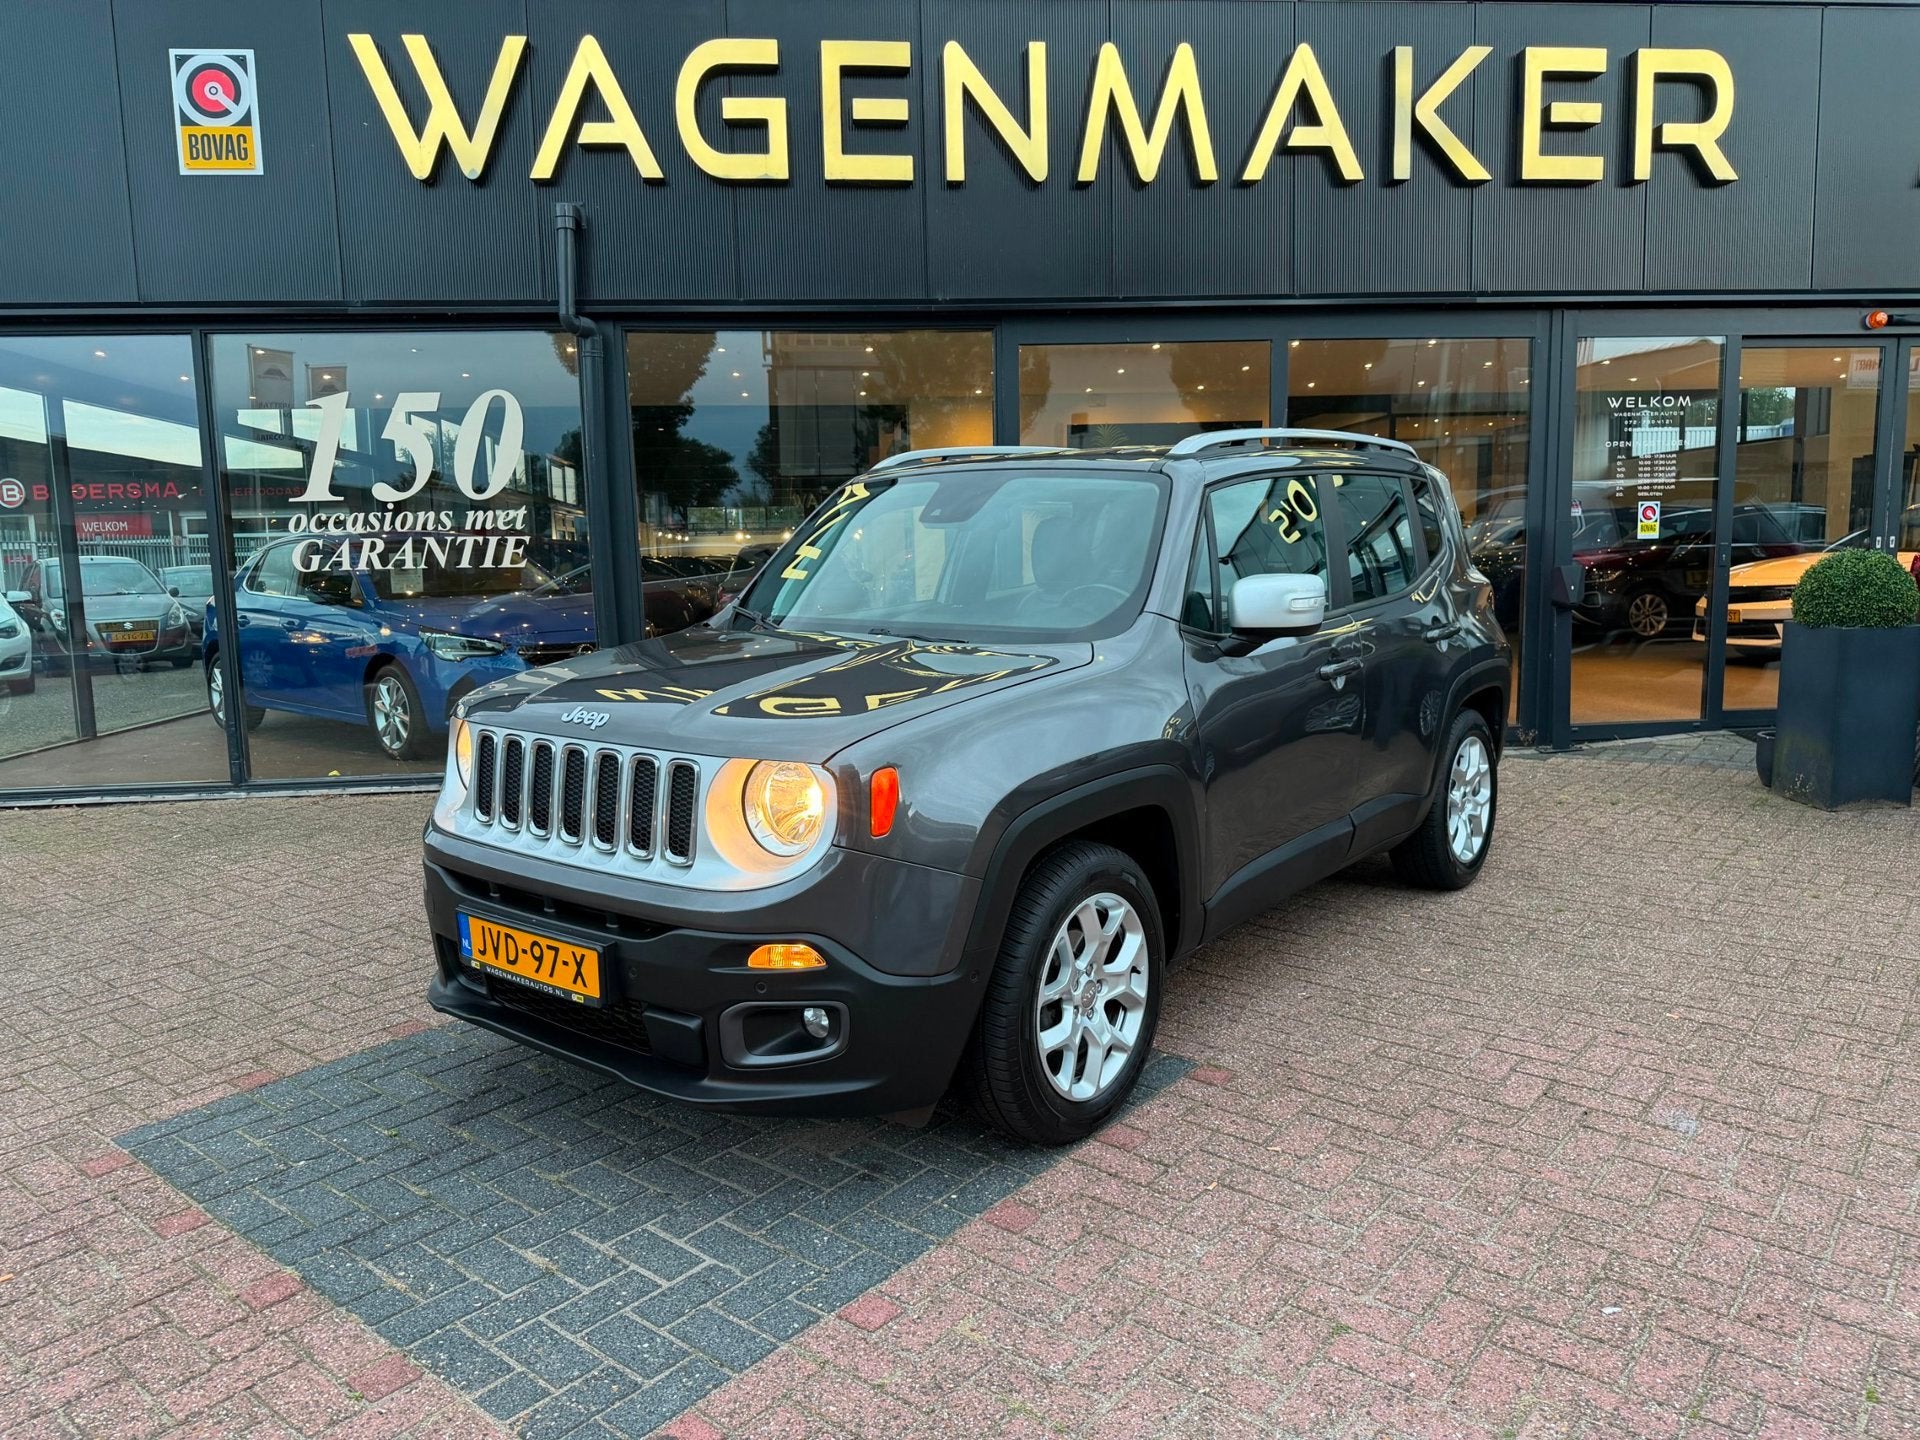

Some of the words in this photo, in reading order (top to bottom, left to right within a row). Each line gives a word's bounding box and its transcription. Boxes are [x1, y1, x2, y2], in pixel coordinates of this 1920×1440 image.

[348, 32, 1739, 183] WAGENMAKER
[187, 133, 249, 161] BOVAG
[1606, 395, 1692, 408] WELKOM
[288, 388, 524, 503] 150
[1605, 439, 1691, 448] OPENDEN
[32, 482, 179, 501] BOERSMA
[82, 521, 129, 532] WELKOM
[287, 502, 453, 534] occasions
[465, 504, 528, 531] met
[291, 535, 532, 573] GARANTIE
[560, 705, 610, 730] Jeep
[461, 937, 472, 950] NL
[477, 925, 588, 989] JVD-97-X
[485, 965, 565, 997] WAGENMAKERAUTOS.NL
